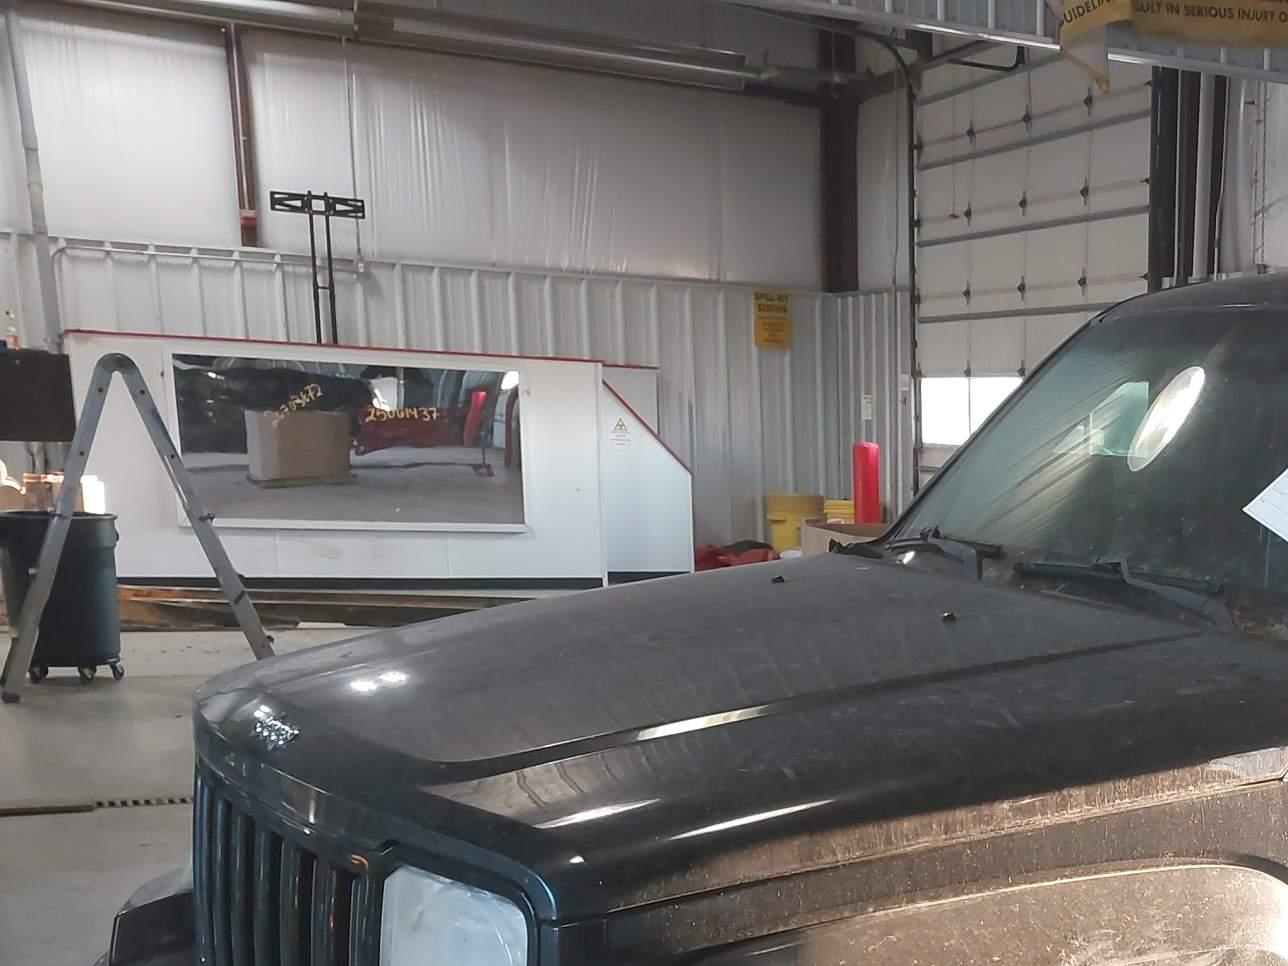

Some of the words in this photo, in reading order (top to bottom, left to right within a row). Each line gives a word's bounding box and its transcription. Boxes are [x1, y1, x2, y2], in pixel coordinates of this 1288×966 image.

[1166, 3, 1180, 15] IN
[1183, 4, 1234, 19] SERIOUS
[1238, 7, 1275, 21] INJURY
